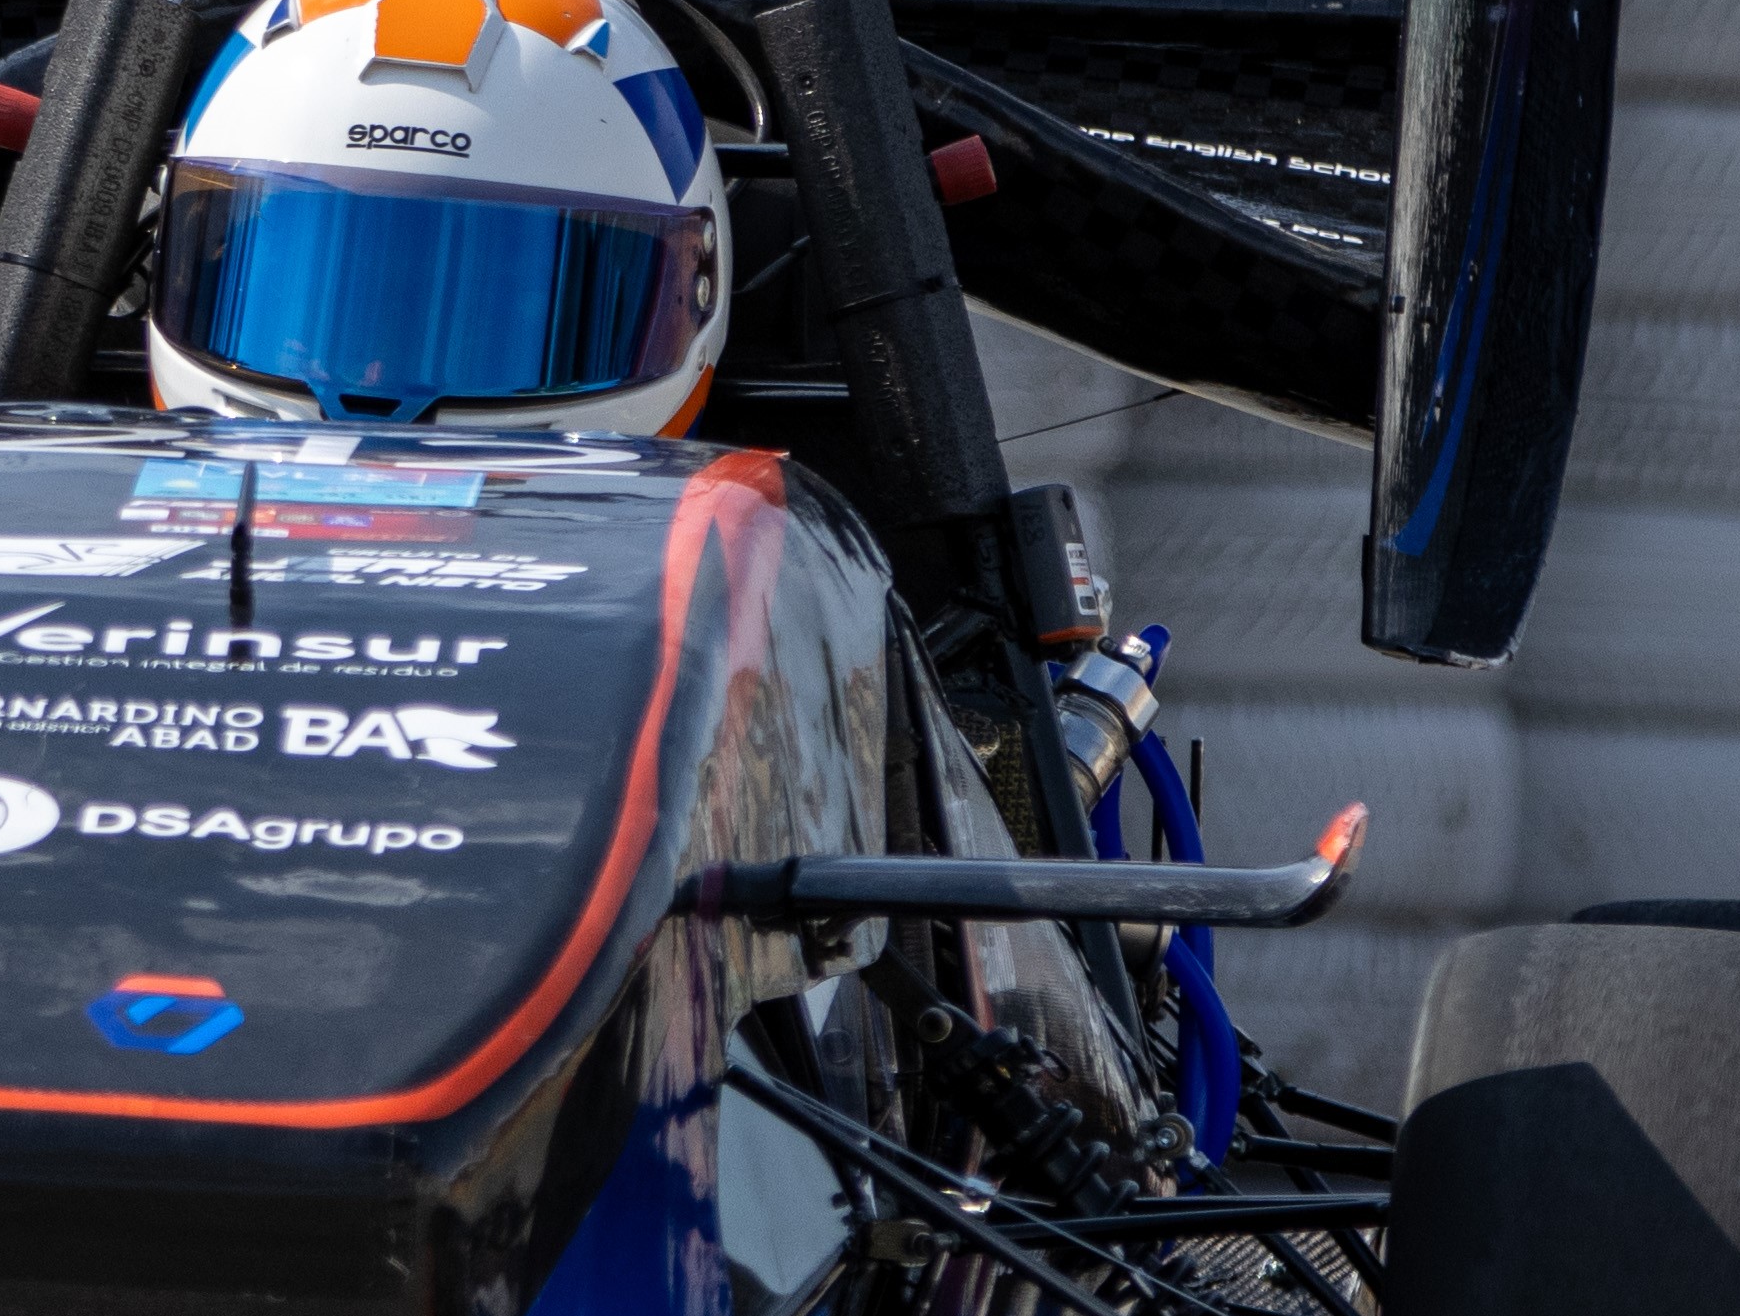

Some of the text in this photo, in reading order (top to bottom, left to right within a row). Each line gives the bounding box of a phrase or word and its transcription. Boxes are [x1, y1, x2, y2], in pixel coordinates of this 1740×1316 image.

[347, 124, 472, 155] sparco
[1146, 135, 1278, 167] English
[1287, 155, 1391, 184] Scho
[377, 574, 547, 591] NIETO
[278, 662, 322, 675] de
[108, 725, 259, 753] ABAD
[77, 804, 465, 855] DSAgrupo
